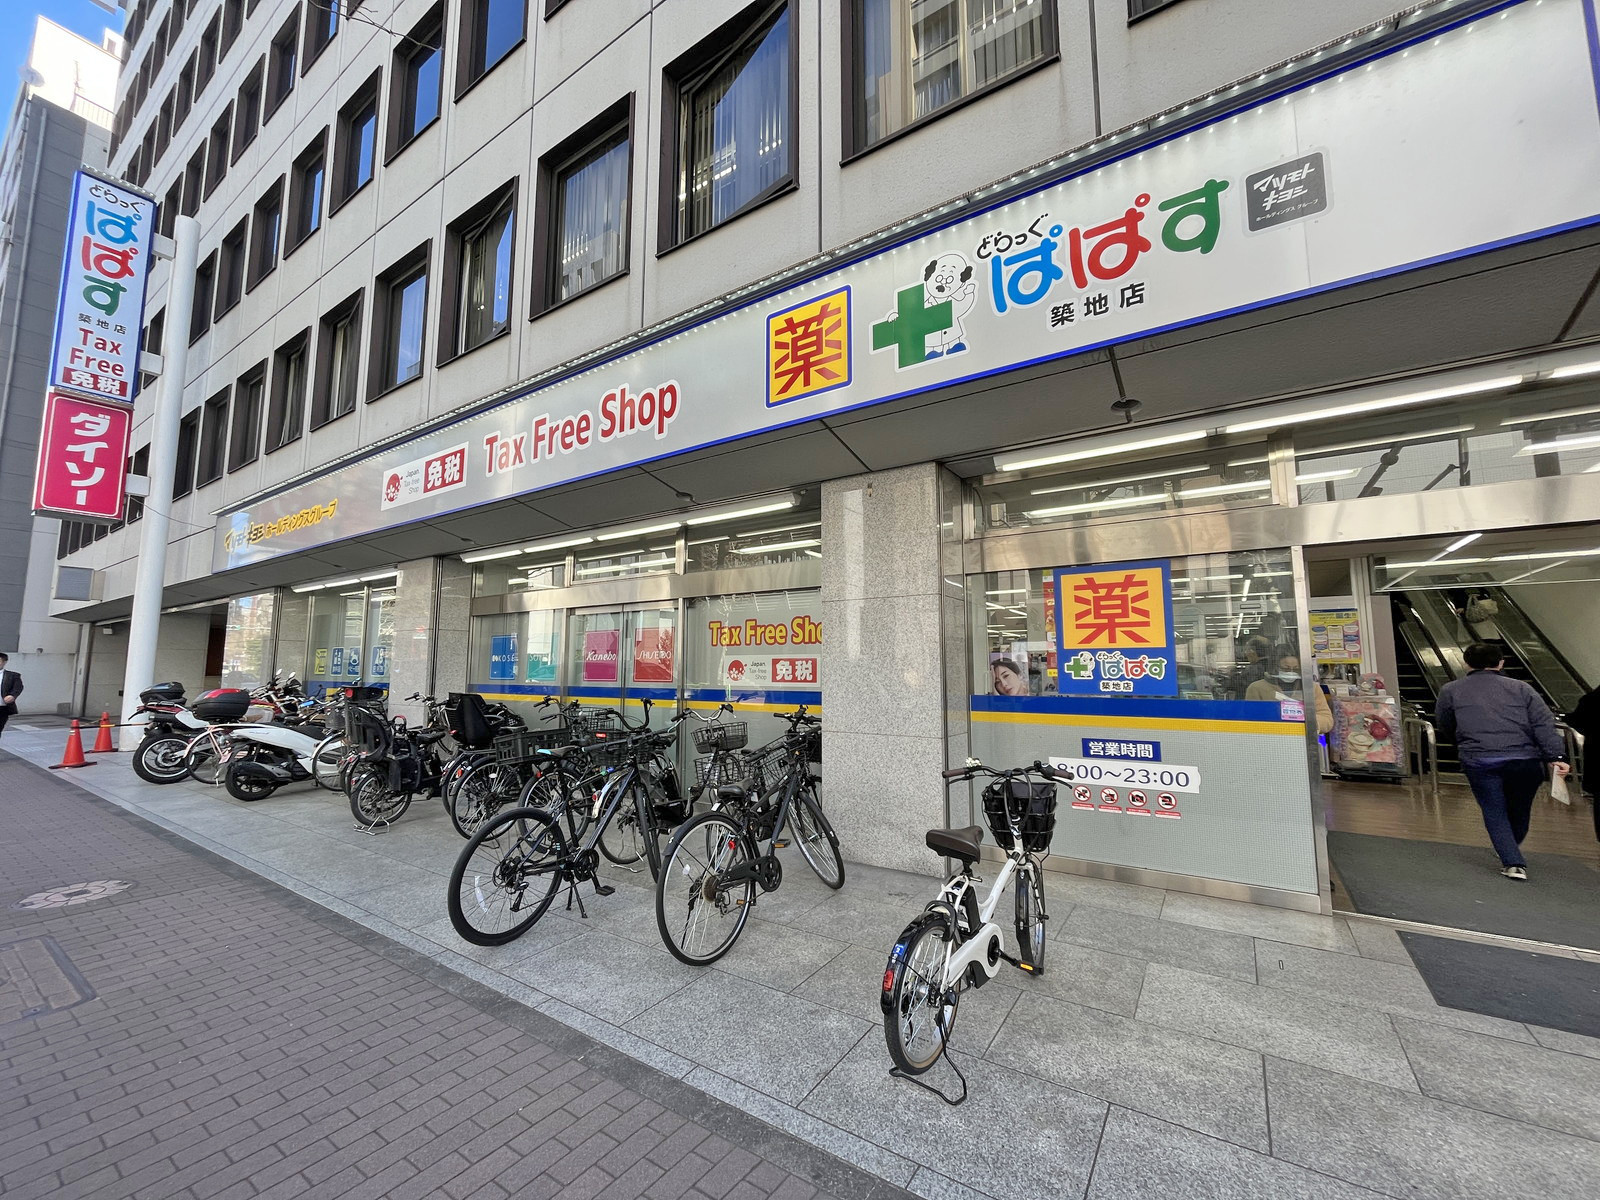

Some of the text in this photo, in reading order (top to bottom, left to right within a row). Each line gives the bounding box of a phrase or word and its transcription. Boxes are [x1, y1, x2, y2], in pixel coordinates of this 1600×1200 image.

[1252, 162, 1316, 193] マツモト
[88, 184, 146, 214] どらっぐ
[1261, 184, 1309, 212] キヨシ
[976, 212, 1049, 260] どらっぐ
[990, 178, 1230, 314] ぱぱす
[81, 200, 143, 317] ぱぱす
[1050, 282, 1146, 328] 築地店
[78, 312, 127, 335] 築地店
[78, 327, 123, 356] Tax
[773, 302, 843, 395] 薬
[69, 346, 125, 377] Free
[69, 370, 121, 395] 免税
[485, 383, 677, 473] Tax Free Shop
[65, 411, 111, 506] ダイソー
[405, 468, 420, 478] Japan
[426, 452, 461, 490] 免税
[408, 486, 420, 495] Shop
[1073, 574, 1151, 645] 薬
[708, 620, 742, 646] Tax
[744, 618, 788, 646] Free
[586, 650, 617, 661] Kanebo
[1101, 656, 1166, 679] ぱぱす
[775, 660, 814, 681] 免税
[1101, 681, 1132, 691] 築地店
[1088, 741, 1154, 758] 営業時間
